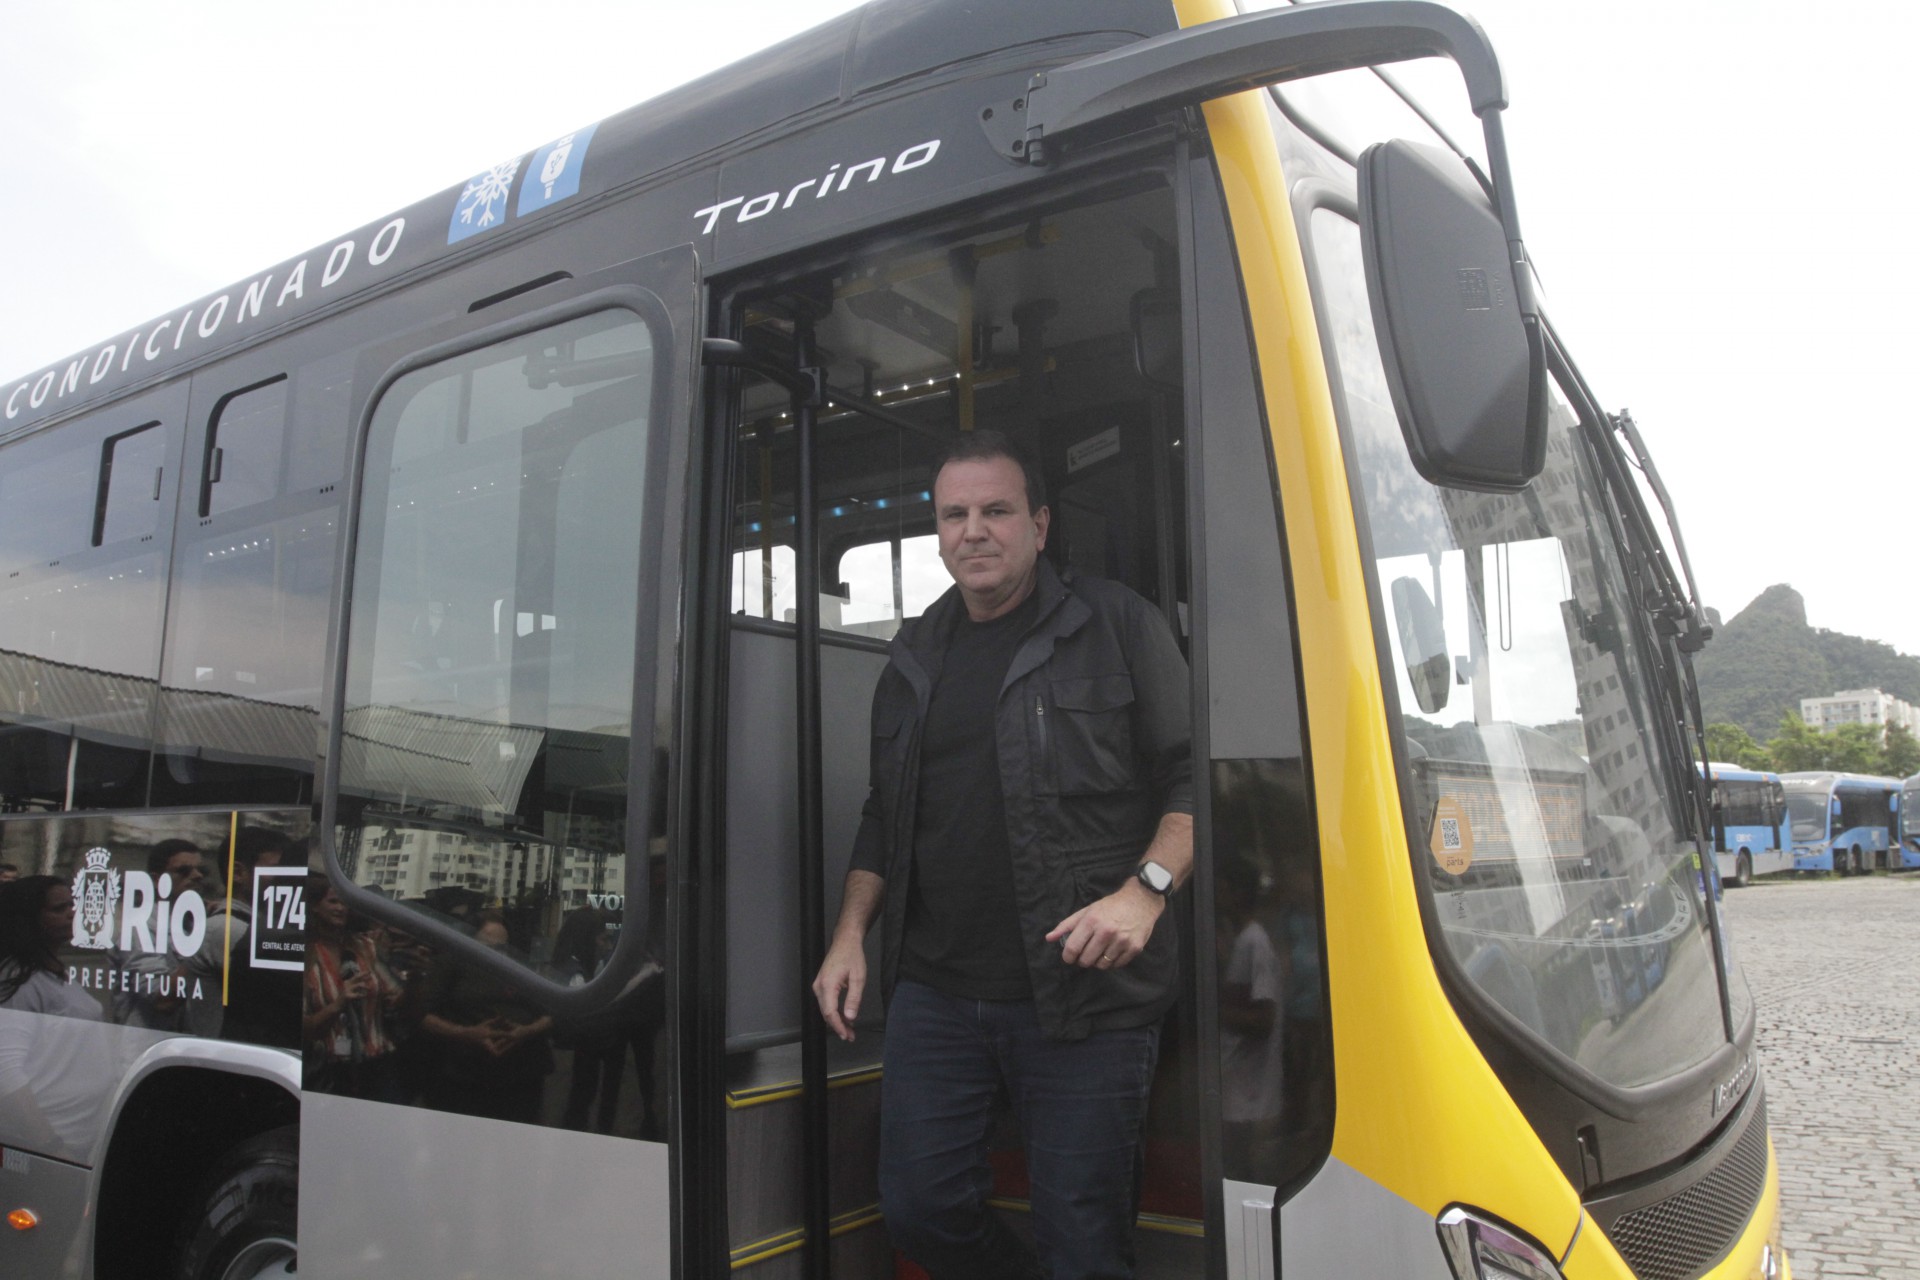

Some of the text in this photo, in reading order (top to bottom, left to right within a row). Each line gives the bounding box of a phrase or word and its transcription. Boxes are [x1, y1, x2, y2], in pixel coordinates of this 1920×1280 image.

[693, 139, 941, 235] Torino
[5, 217, 406, 419] CONDICIONADO
[120, 870, 207, 957] Rio
[262, 941, 283, 951] CENTRAL
[283, 942, 290, 951] DE
[68, 965, 203, 1000] PREFEITURA
